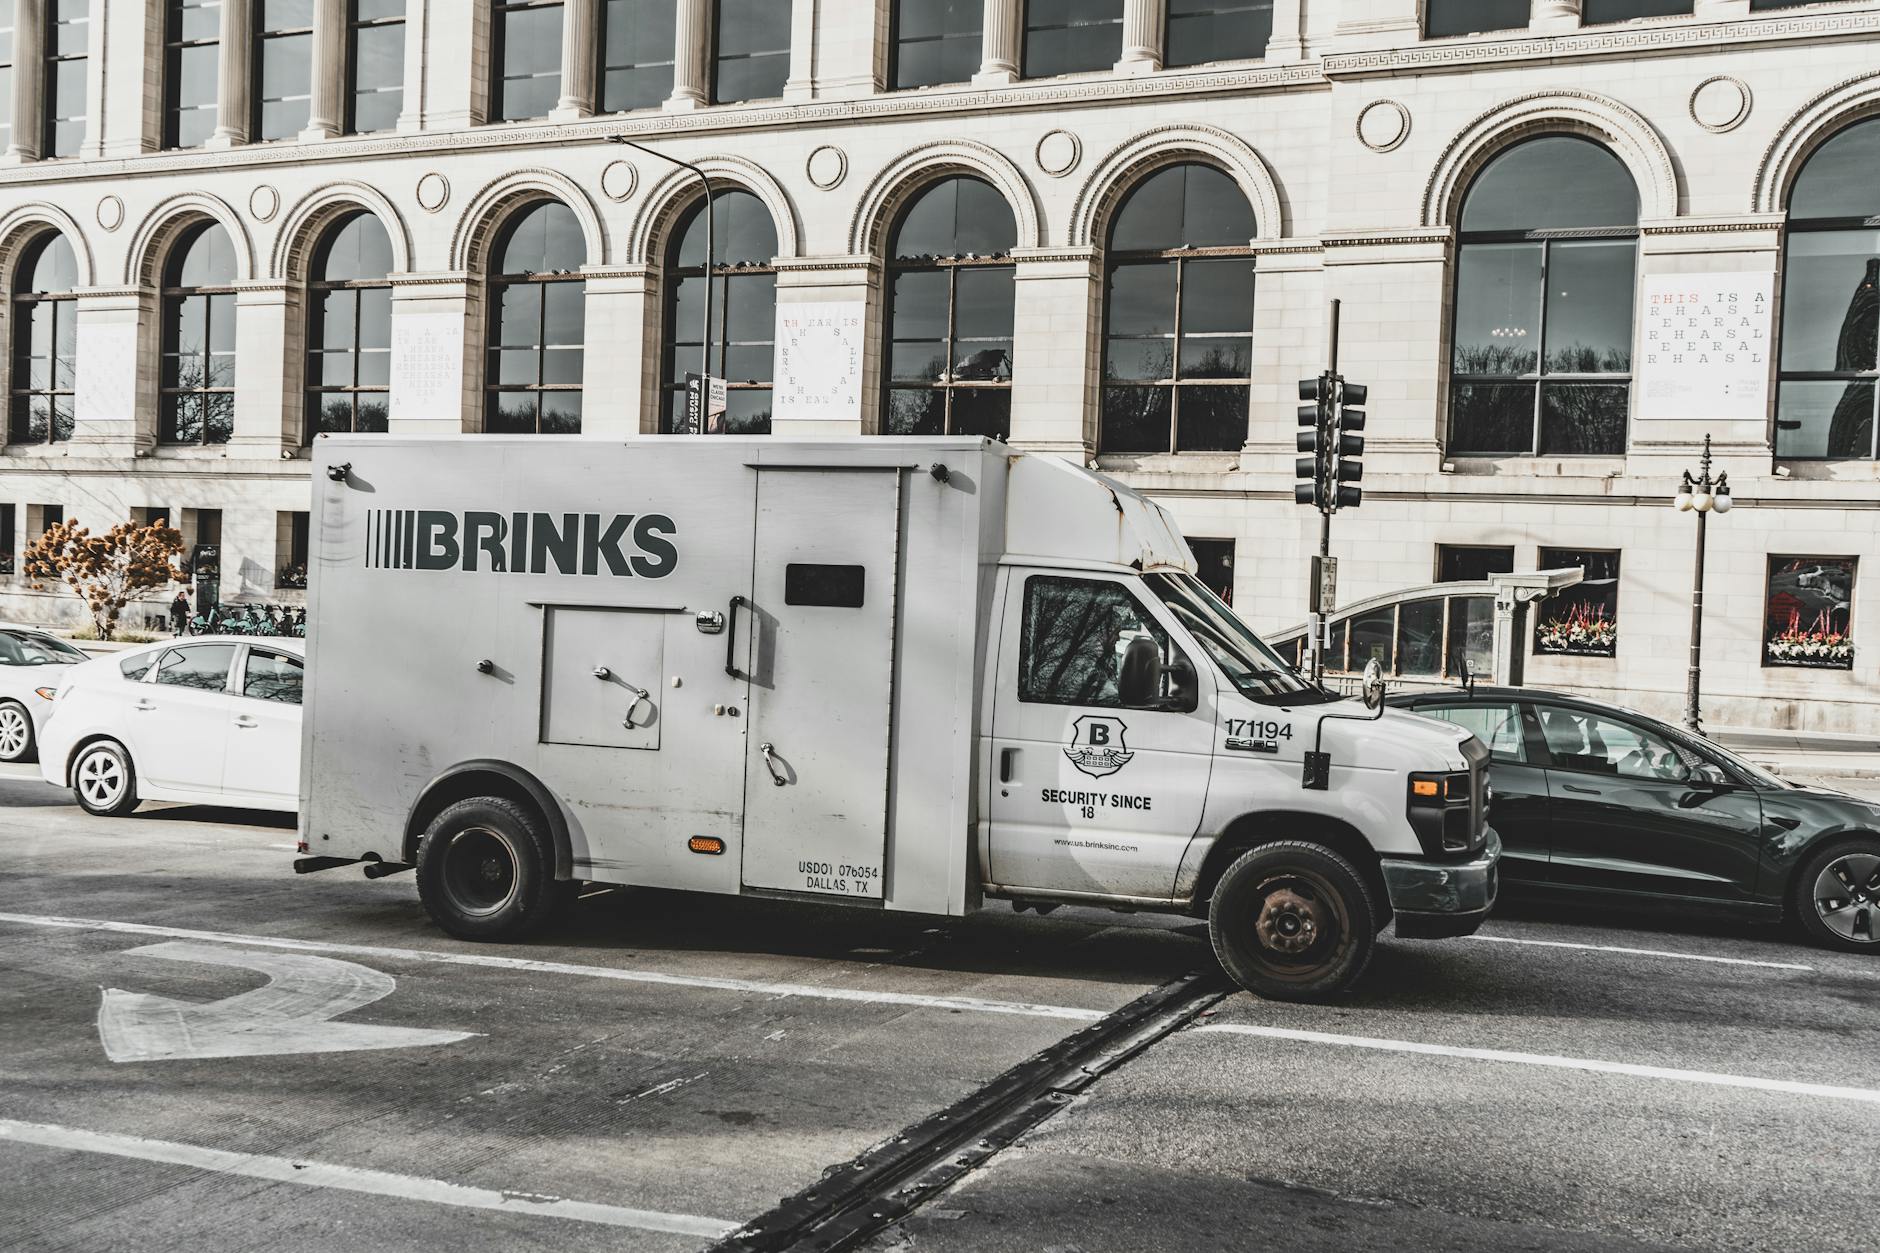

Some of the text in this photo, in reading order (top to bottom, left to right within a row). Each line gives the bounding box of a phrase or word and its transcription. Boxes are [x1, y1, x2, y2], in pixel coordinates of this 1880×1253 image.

[1651, 292, 1764, 304] THIS IS A
[415, 510, 679, 579] BRINKS
[1089, 724, 1110, 745] B
[1225, 719, 1292, 740] 171194
[1042, 789, 1152, 810] SECURITY SINCE
[1054, 838, 1138, 852] www.us.brinksinc.com
[807, 877, 868, 893] DALLAS, TX
